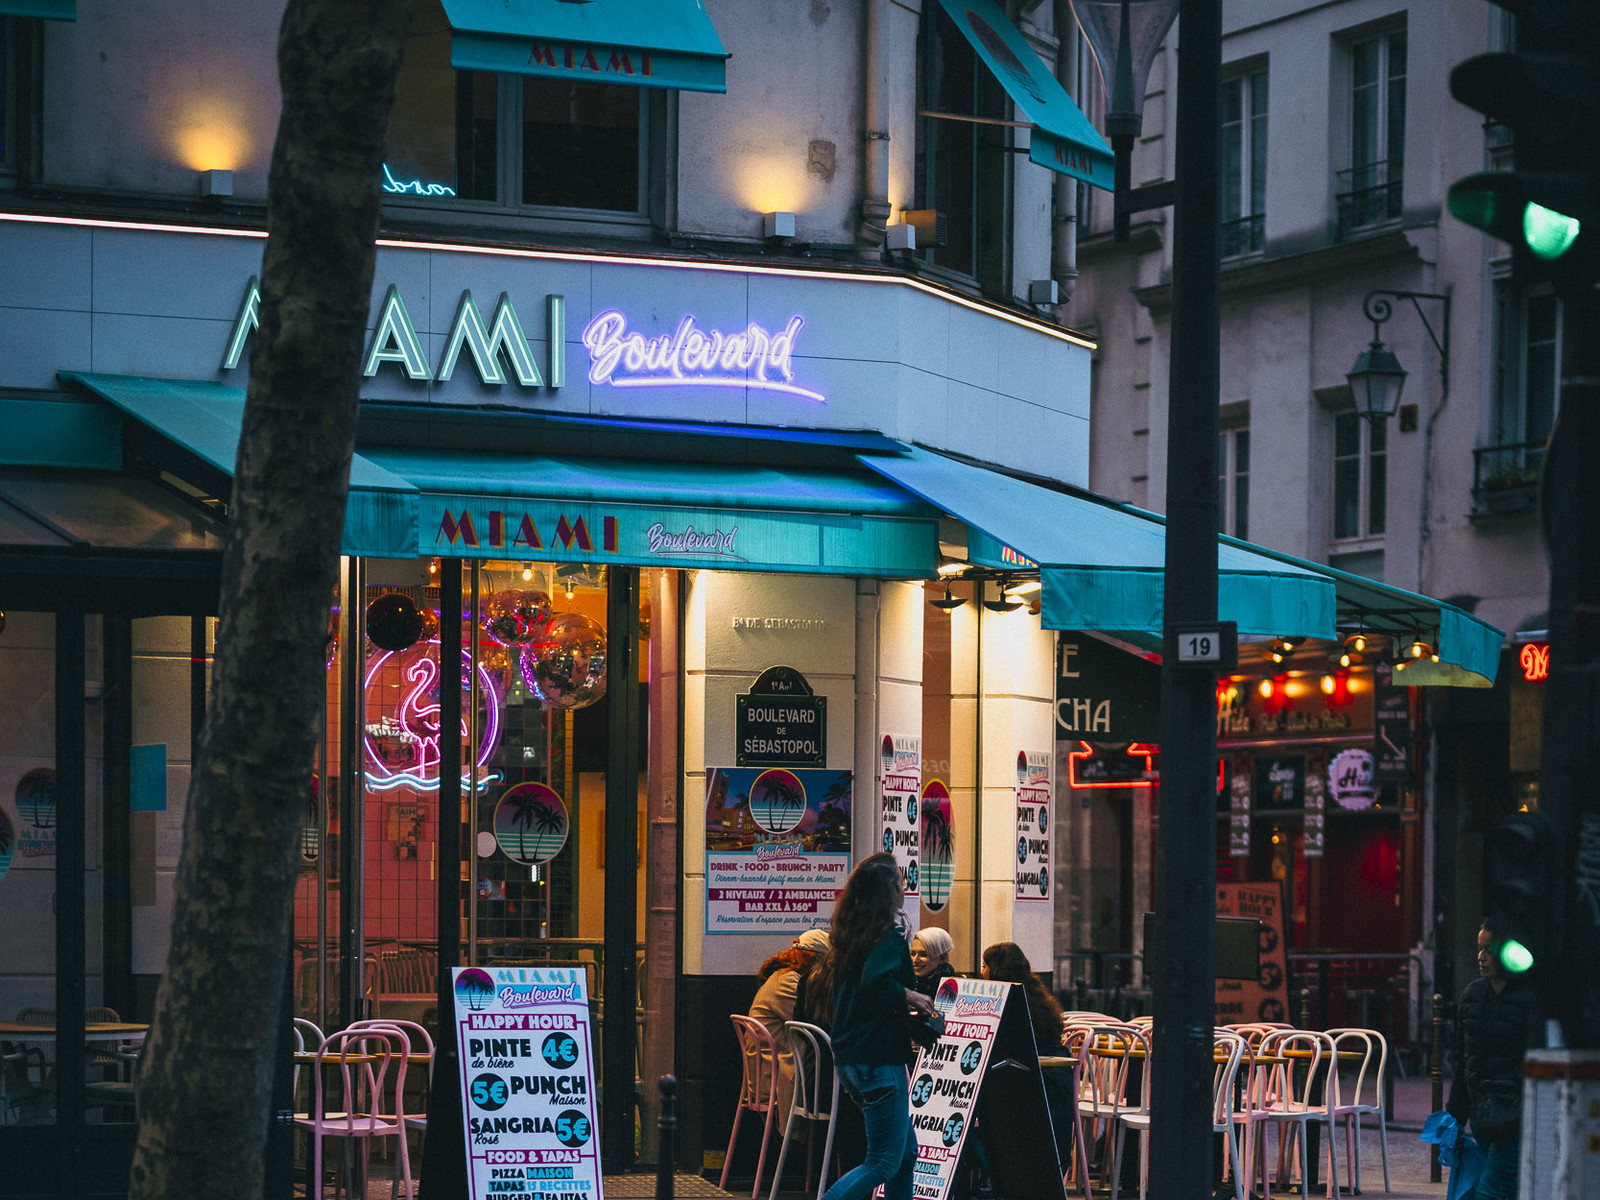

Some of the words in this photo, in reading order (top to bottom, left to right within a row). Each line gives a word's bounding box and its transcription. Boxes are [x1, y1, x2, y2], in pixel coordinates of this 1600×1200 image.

[528, 43, 653, 77] MIAMI
[1055, 144, 1093, 176] MIAMI
[220, 275, 565, 388] AMI
[583, 309, 813, 390] Boulevard
[436, 508, 619, 553] MIAMI
[647, 522, 741, 557] Boulevard
[1189, 637, 1211, 656] 19
[748, 708, 815, 723] BOULEVARD
[777, 727, 787, 735] DE
[745, 736, 819, 755] SÉBASTOPOL
[896, 738, 919, 751] MIAMI
[1028, 753, 1049, 766] MIAMI
[885, 775, 902, 790] HAPPY
[903, 777, 918, 792] HOUR
[1021, 789, 1034, 802] HAPPY
[1035, 791, 1048, 804] HOUR
[883, 795, 902, 813] PINTE
[907, 801, 918, 819] 4€
[1017, 806, 1034, 823] PINTE
[756, 833, 801, 843] MIAMI
[883, 833, 894, 851] 5€
[895, 830, 919, 847] PUNCH
[756, 843, 803, 861] Boulevard
[1028, 839, 1049, 855] PUNCH
[710, 862, 738, 871] DRINK
[745, 863, 769, 871] FOOD
[776, 863, 811, 872] BRUNCH
[818, 864, 845, 872] PARTY
[787, 875, 804, 883] made
[815, 875, 836, 883] Miami
[908, 867, 918, 884] 5€
[1017, 871, 1040, 888] SANGRIA
[718, 890, 724, 899] 2
[726, 891, 766, 900] NIVEAUX
[778, 891, 783, 899] 2
[785, 890, 836, 900] AMBIANCES
[745, 903, 764, 912] BAR
[766, 903, 782, 912] XXL
[784, 900, 792, 912] À
[716, 914, 754, 924] Réservation
[756, 914, 783, 924] d'espace
[801, 915, 812, 924] les
[812, 917, 832, 927] group
[496, 969, 578, 983] MIAMI
[500, 983, 577, 1008] Boulevard
[961, 981, 1005, 997] MIAMI
[955, 995, 1000, 1017] Boulevard
[472, 1015, 524, 1030] HAPPY
[525, 1014, 575, 1030] HOUR
[962, 1023, 989, 1039] HOUR
[469, 1038, 531, 1057] PINTE
[542, 1038, 576, 1062] 4€
[961, 1046, 982, 1069] 4€
[471, 1058, 485, 1068] de
[487, 1056, 515, 1069] bière
[920, 1058, 929, 1069] de
[473, 1080, 507, 1105] 5€
[511, 1076, 587, 1095] PUNCH
[911, 1078, 932, 1103] 5€
[933, 1078, 976, 1100] PUNCH
[549, 1093, 587, 1106] Maison
[948, 1097, 970, 1109] Maison
[470, 1117, 555, 1134] SANGRIA
[557, 1117, 590, 1142] 5€
[910, 1113, 944, 1132] NGRIA
[943, 1119, 965, 1143] 5€
[474, 1133, 500, 1145] Rosé
[487, 1151, 526, 1163] FOOD
[528, 1151, 539, 1162] &
[541, 1150, 580, 1163] TAPAS
[927, 1148, 949, 1161] TAPAS
[491, 1168, 525, 1179] PIZZA
[527, 1168, 573, 1179] MAISON
[914, 1161, 941, 1174] MAISON
[489, 1181, 525, 1192] TAPAS
[527, 1181, 536, 1191] 15
[539, 1181, 592, 1191] RECETTES
[918, 1175, 946, 1187] RECETTES
[916, 1185, 940, 1198] FAJITAS
